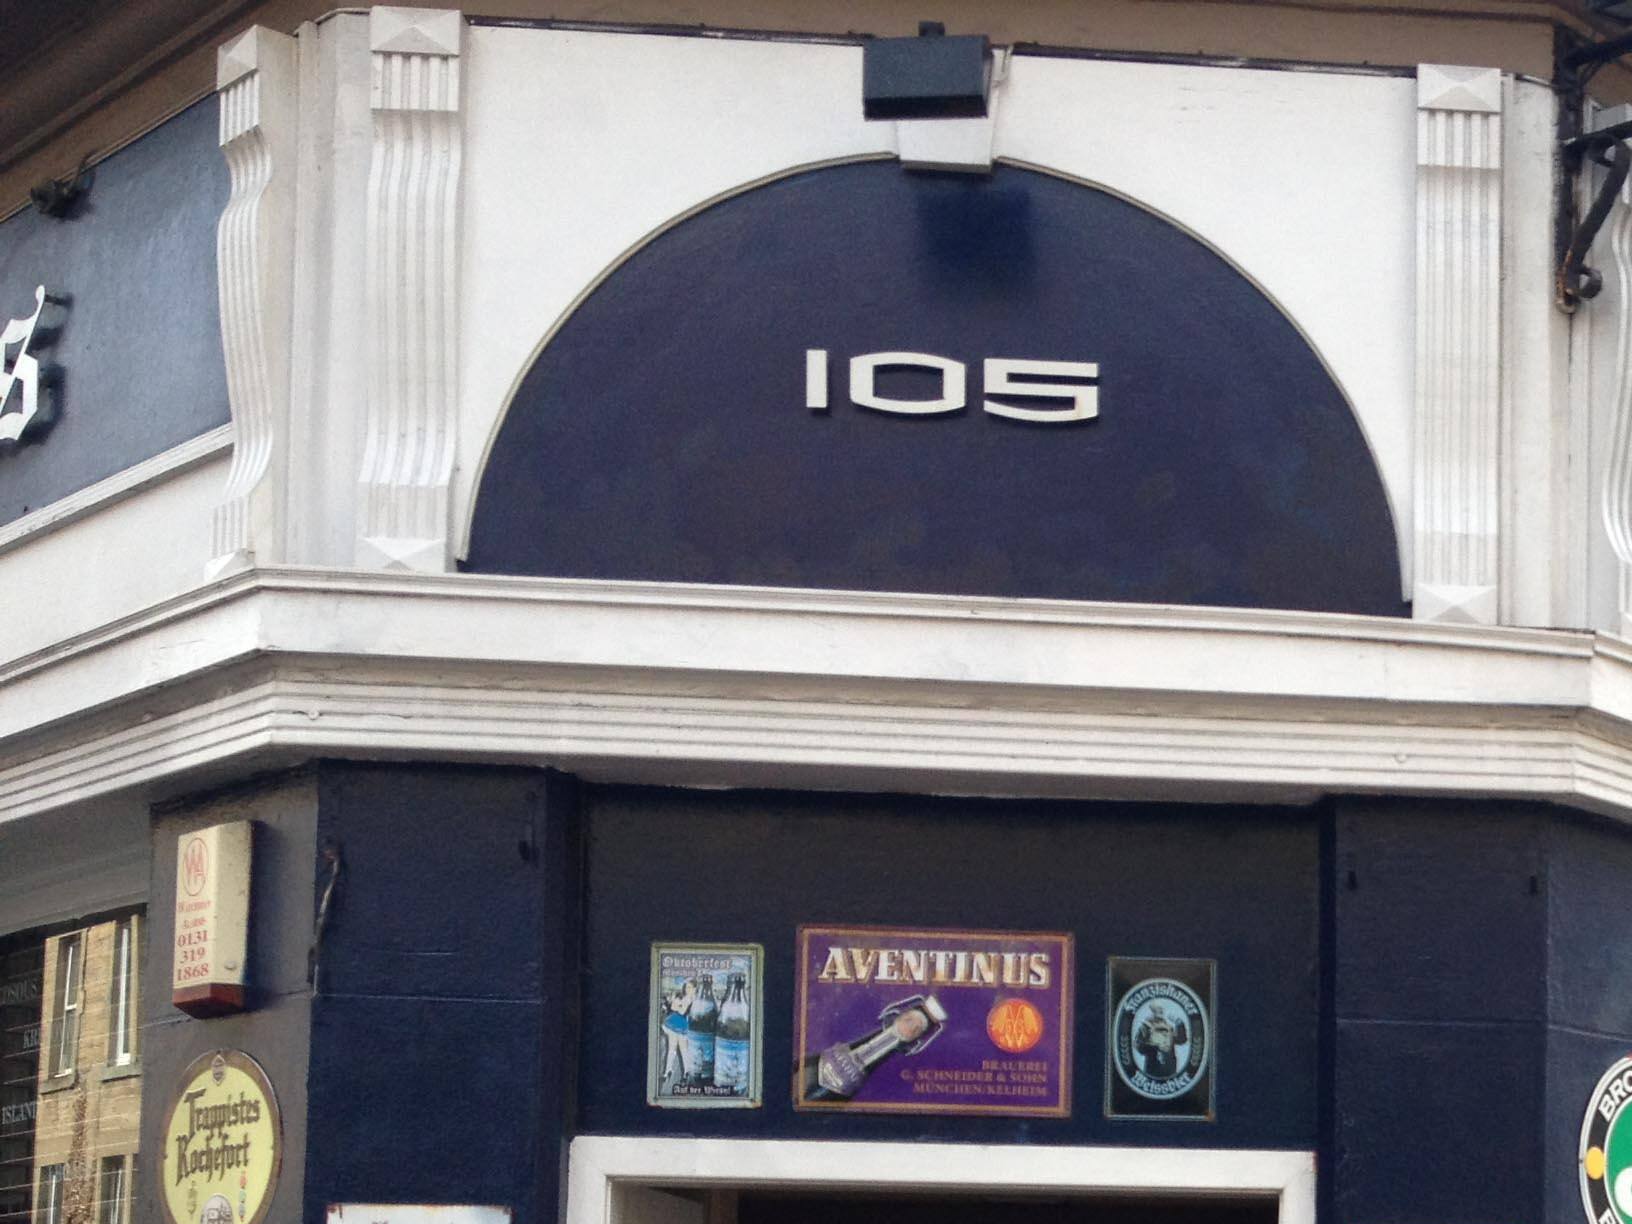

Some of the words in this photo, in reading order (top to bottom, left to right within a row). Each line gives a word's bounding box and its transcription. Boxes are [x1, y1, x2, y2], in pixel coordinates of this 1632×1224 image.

[807, 350, 1098, 422] 105
[178, 930, 208, 947] 0131
[180, 948, 206, 964] 319
[818, 947, 1050, 988] AVENTINUS
[177, 963, 209, 981] 1868
[176, 1132, 251, 1187] Rochefort
